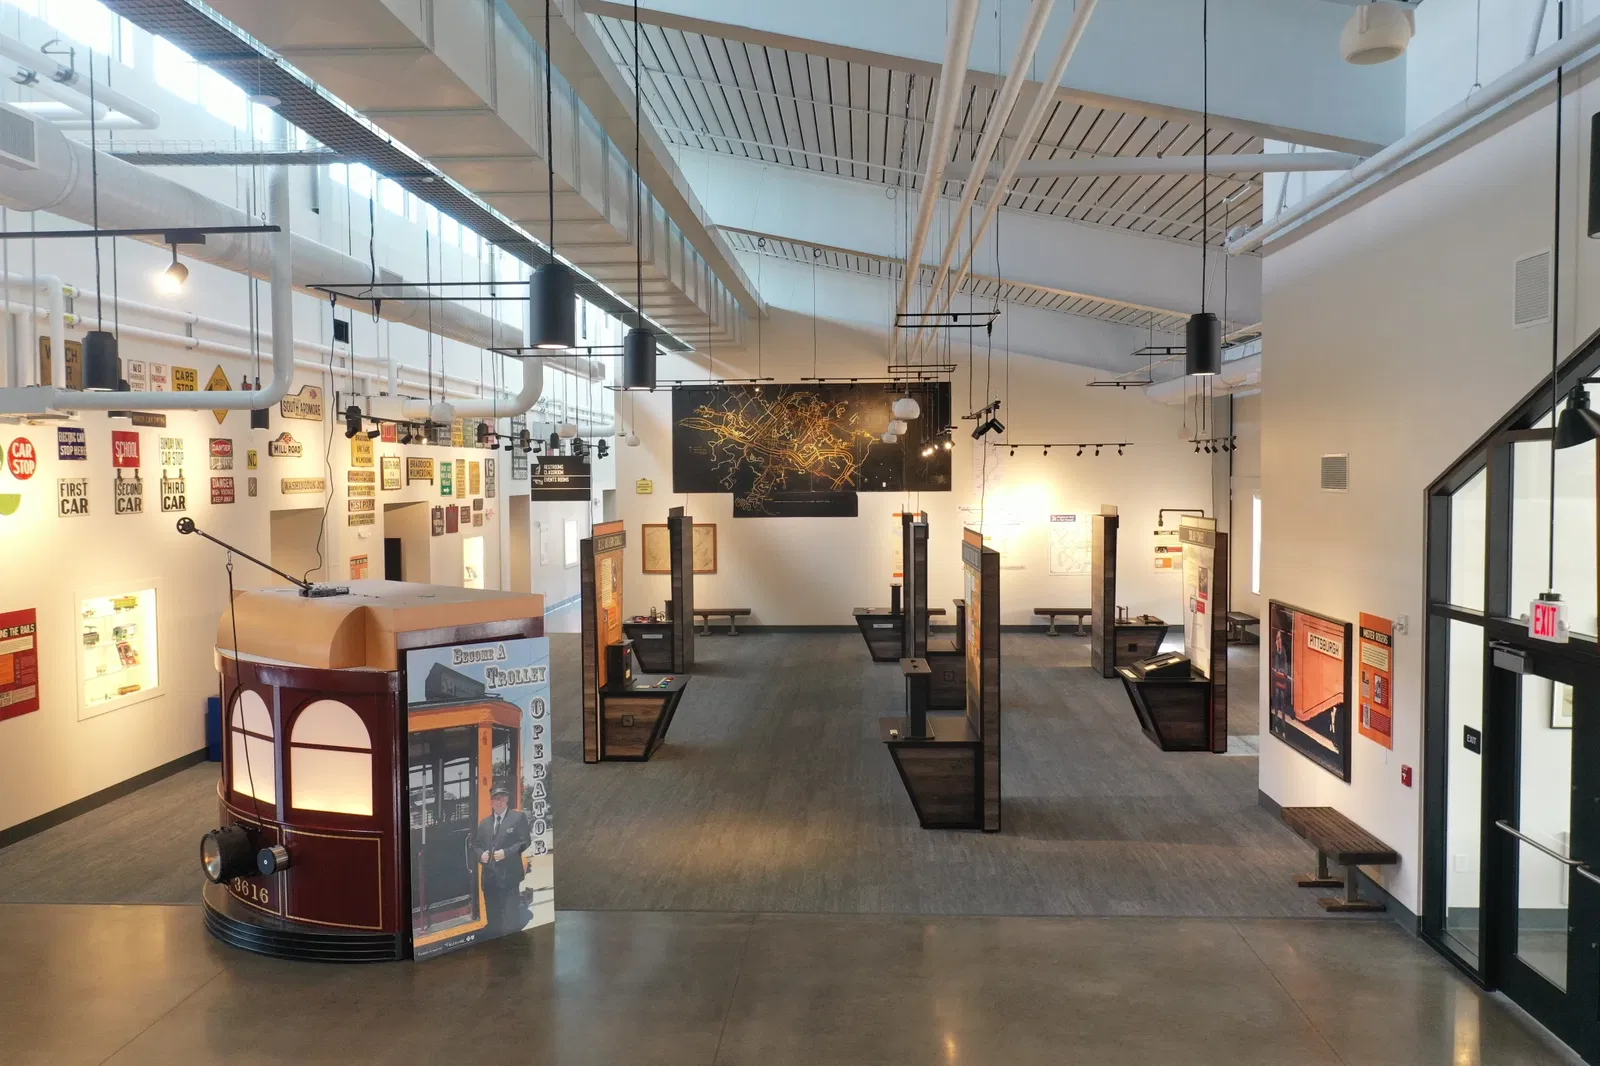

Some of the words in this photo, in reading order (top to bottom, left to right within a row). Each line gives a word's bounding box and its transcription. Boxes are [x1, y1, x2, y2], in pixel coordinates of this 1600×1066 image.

[175, 370, 194, 382] CARS
[283, 400, 300, 413] SOUTH
[300, 402, 321, 416] ARDMORE
[58, 431, 76, 442] ELECTRIC
[76, 432, 85, 443] CAR
[12, 442, 33, 458] CAR
[60, 445, 74, 456] STOP
[74, 446, 87, 456] HERE
[115, 441, 139, 458] SCHOOL
[273, 444, 287, 454] MILL
[288, 445, 301, 454] ROAD
[161, 451, 171, 466] CAR
[172, 451, 184, 466] STOP
[409, 460, 431, 468] BRADDOCK
[13, 459, 35, 475] STOP
[485, 459, 494, 476] 19
[60, 482, 88, 497] FIRST
[117, 483, 142, 496] SECOND
[163, 481, 185, 494] THIRD
[211, 478, 233, 488] DANGER
[61, 498, 89, 514] CAR
[117, 497, 142, 513] CAR
[163, 495, 186, 510] CAR
[350, 500, 361, 510] WEST
[362, 499, 375, 509] PARK
[1533, 604, 1557, 637] EXIT
[9, 626, 19, 637] THE
[20, 623, 35, 635] RAILS
[1362, 628, 1376, 640] MISTER
[1375, 632, 1389, 645] ROGERS
[497, 644, 506, 660] A
[1309, 634, 1340, 656] PITTSBURGH
[486, 666, 547, 689] TROLLEY
[1466, 733, 1477, 745] EXIT
[530, 698, 547, 856] OPERATOR
[234, 876, 269, 904] 3616
